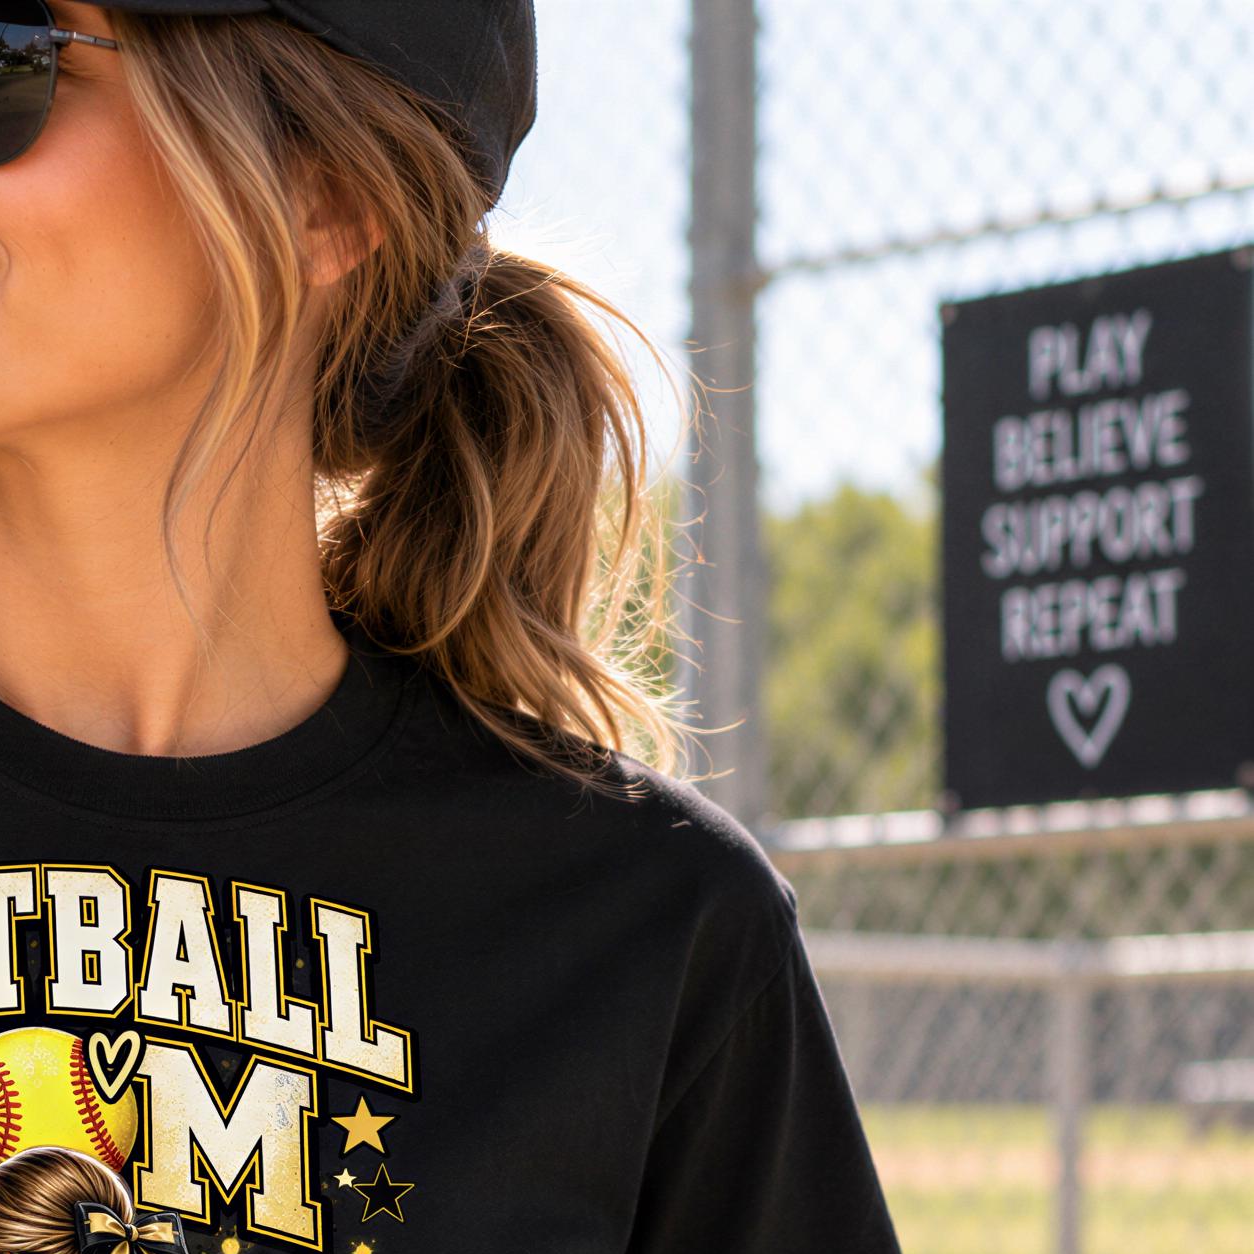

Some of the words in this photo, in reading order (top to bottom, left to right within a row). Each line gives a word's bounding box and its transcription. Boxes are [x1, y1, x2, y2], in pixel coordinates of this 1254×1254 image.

[1028, 306, 1153, 400] PLAY
[993, 388, 1192, 493] BELIEVE
[980, 475, 1205, 580] SUPPORT
[1000, 567, 1186, 663] REPEAT
